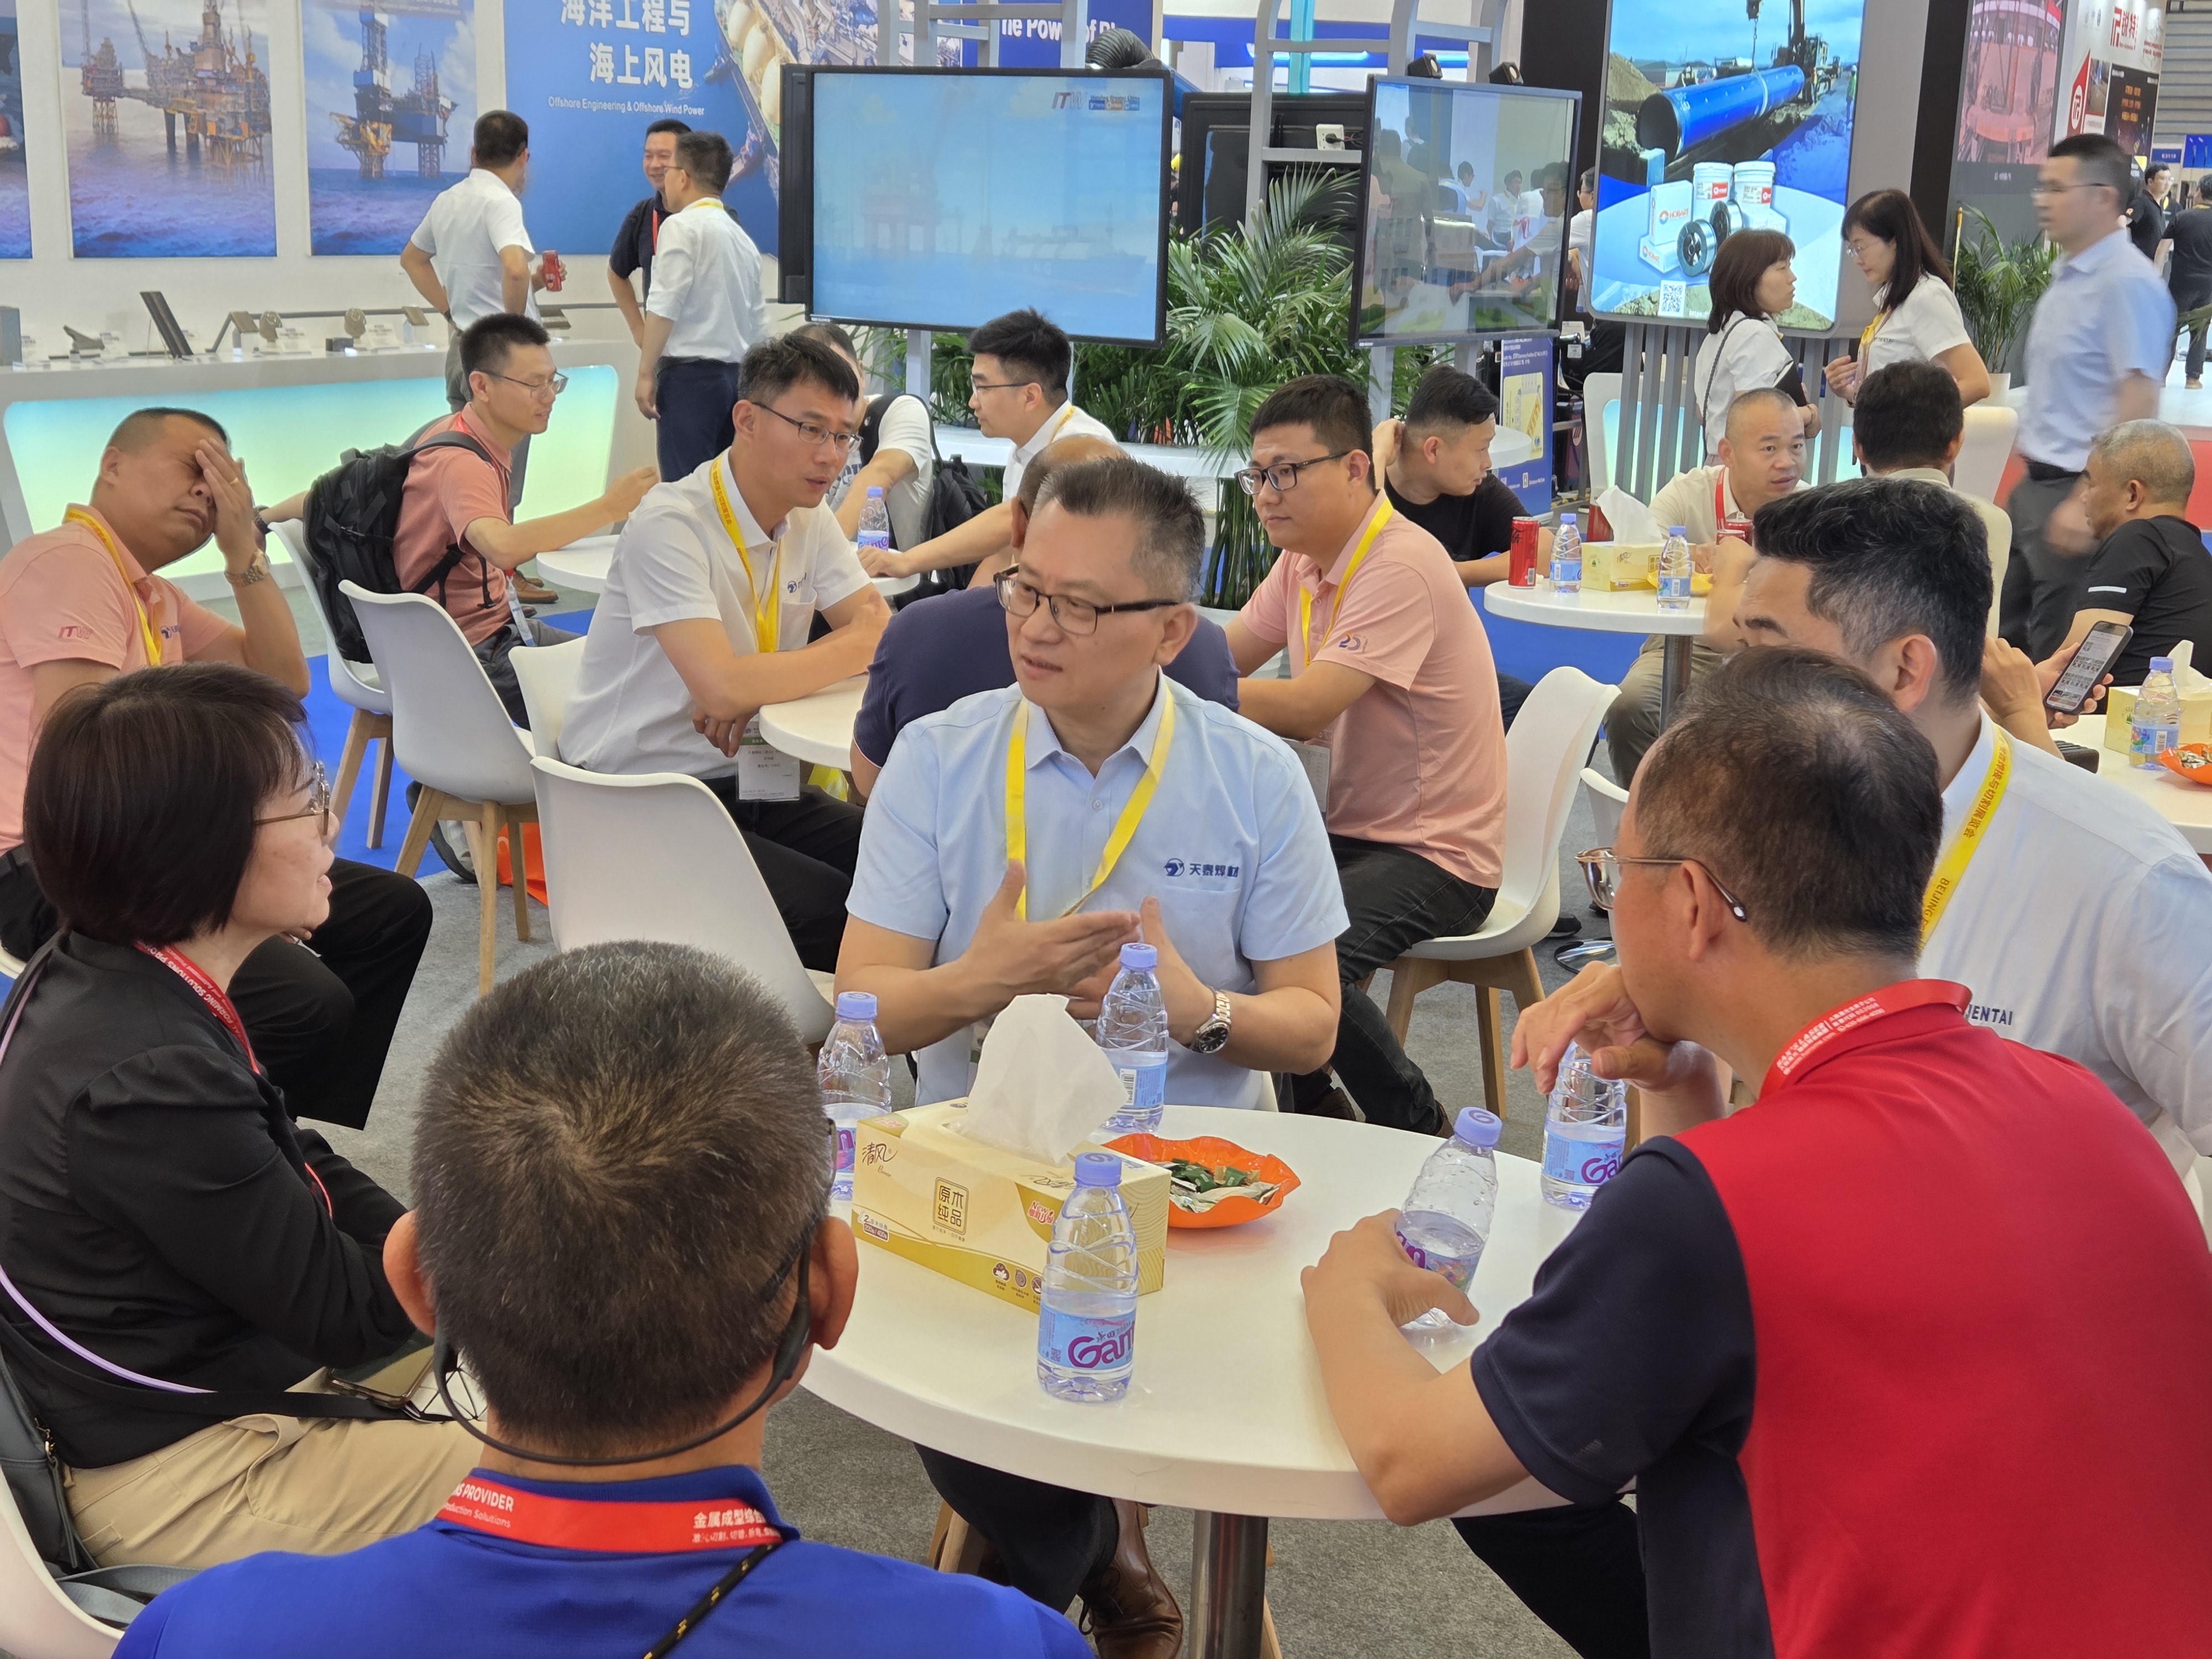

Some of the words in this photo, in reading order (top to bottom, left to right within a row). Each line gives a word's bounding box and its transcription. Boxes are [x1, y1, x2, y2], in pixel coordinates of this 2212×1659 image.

[589, 42, 692, 88] 海上风电
[548, 96, 581, 108] Offshore
[582, 98, 625, 113] Engineering
[627, 102, 632, 111] &
[633, 102, 663, 113] Offshore
[664, 103, 682, 114] Wind
[684, 105, 705, 116] Power
[58, 625, 93, 640] ITW
[862, 1142, 898, 1165] 清风
[938, 1185, 964, 1209] 原木
[937, 1203, 962, 1227] 纯品
[462, 1484, 514, 1512] PROVIDER
[473, 1509, 511, 1528] Solutions
